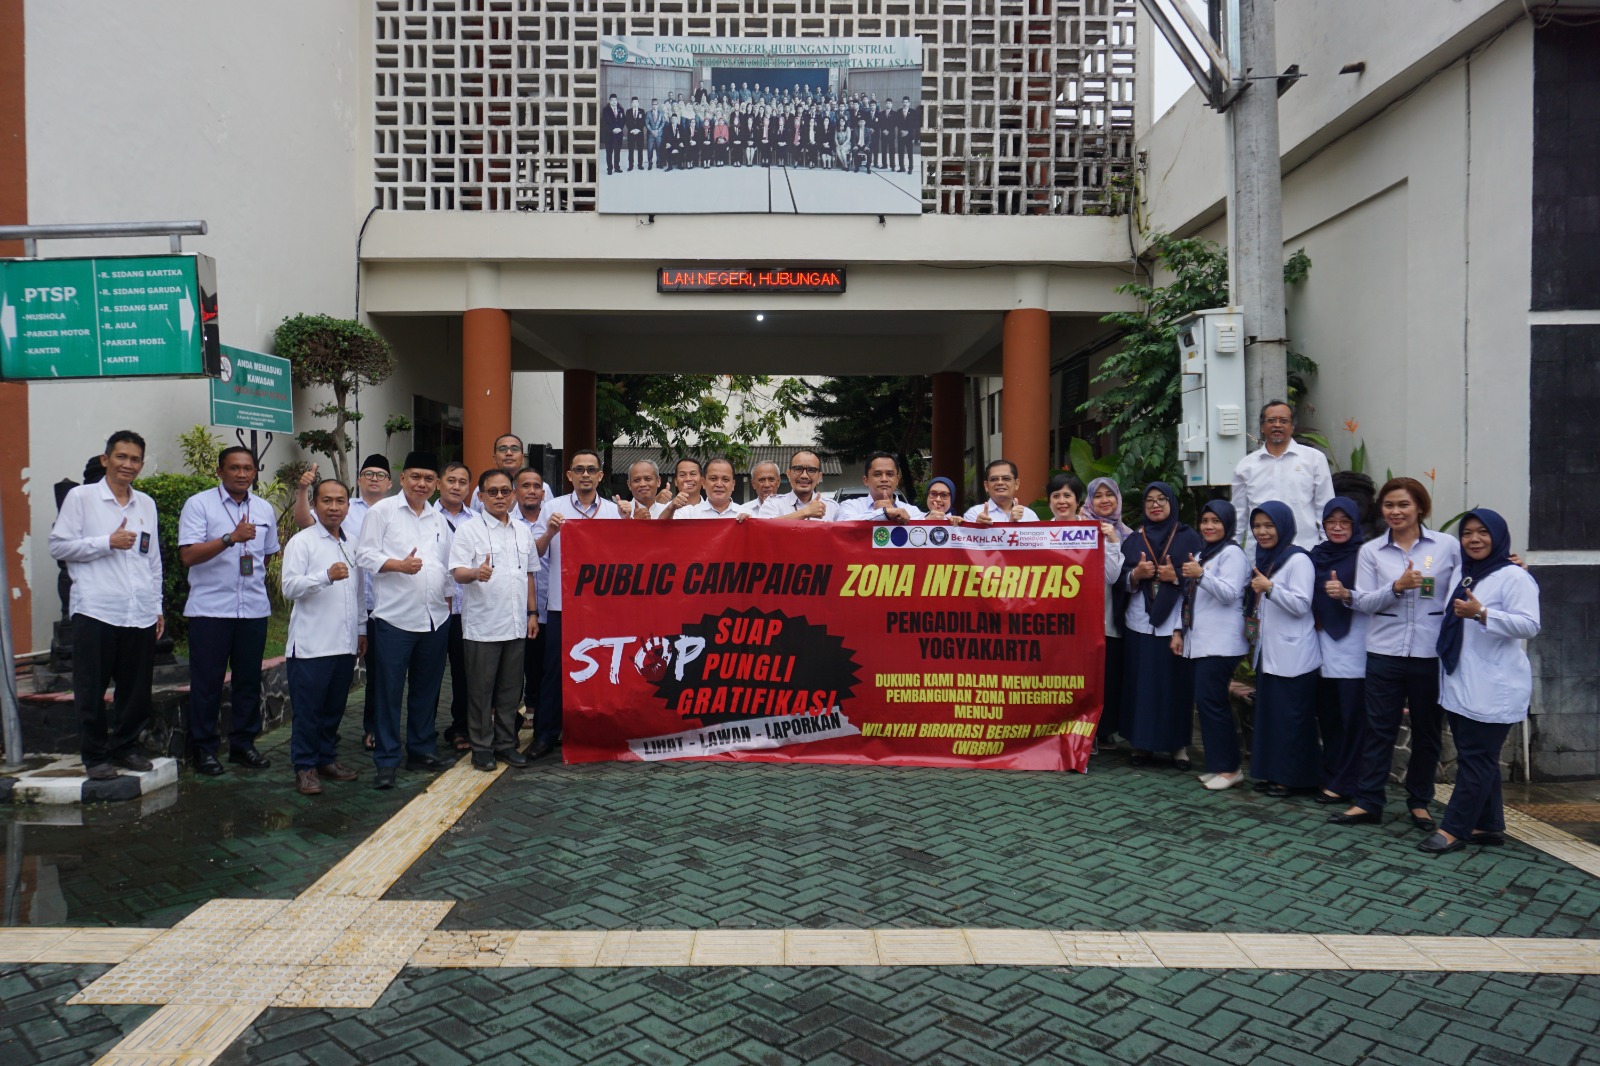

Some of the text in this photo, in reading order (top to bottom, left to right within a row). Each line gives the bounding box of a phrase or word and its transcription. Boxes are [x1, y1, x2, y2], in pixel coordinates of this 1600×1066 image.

[655, 43, 723, 53] PENGADILAN
[771, 44, 830, 54] HUBUNGAN
[832, 45, 896, 54] INDUSTRIAL
[659, 57, 700, 67] TINDAK
[791, 58, 864, 67] YOGYAKARTA
[866, 58, 901, 67] KELAS
[146, 269, 183, 277] KARTIKA
[662, 272, 840, 287] ILAN NEGERI, HUBUNGAN
[113, 287, 145, 295] SIDANG
[147, 286, 181, 294] GARUDA
[237, 359, 283, 376] ANDA MEMASUKI
[247, 373, 275, 387] KAWASAN
[951, 533, 1004, 543] BerAKHLAK
[1061, 530, 1097, 541] KAN
[574, 562, 1084, 599] PUBLIC CAMPAIGN ZONA INTEGRITAS
[886, 611, 1075, 635] PENGADILAN NEGERI
[714, 617, 783, 646] SUAP
[918, 637, 1042, 662] YOGYAKARTA
[569, 633, 706, 685] STOP
[702, 653, 796, 683] PUNGLI
[875, 673, 1085, 690] DUKUNG KAMI DALAM MEWUJUDKAN
[676, 686, 837, 717] GRATIFIKASI
[886, 689, 1074, 705] PEMBANGUNAN ZONA INTEGRITAS
[954, 705, 1003, 720] MENUJU
[643, 736, 684, 755] LIHAT
[699, 726, 752, 749] LAWAN
[765, 712, 842, 740] LAPORKAN
[861, 720, 1095, 739] WILAYAH BIROKRASI BERSIH MELAYANI
[952, 740, 1004, 756] (WBBM)
